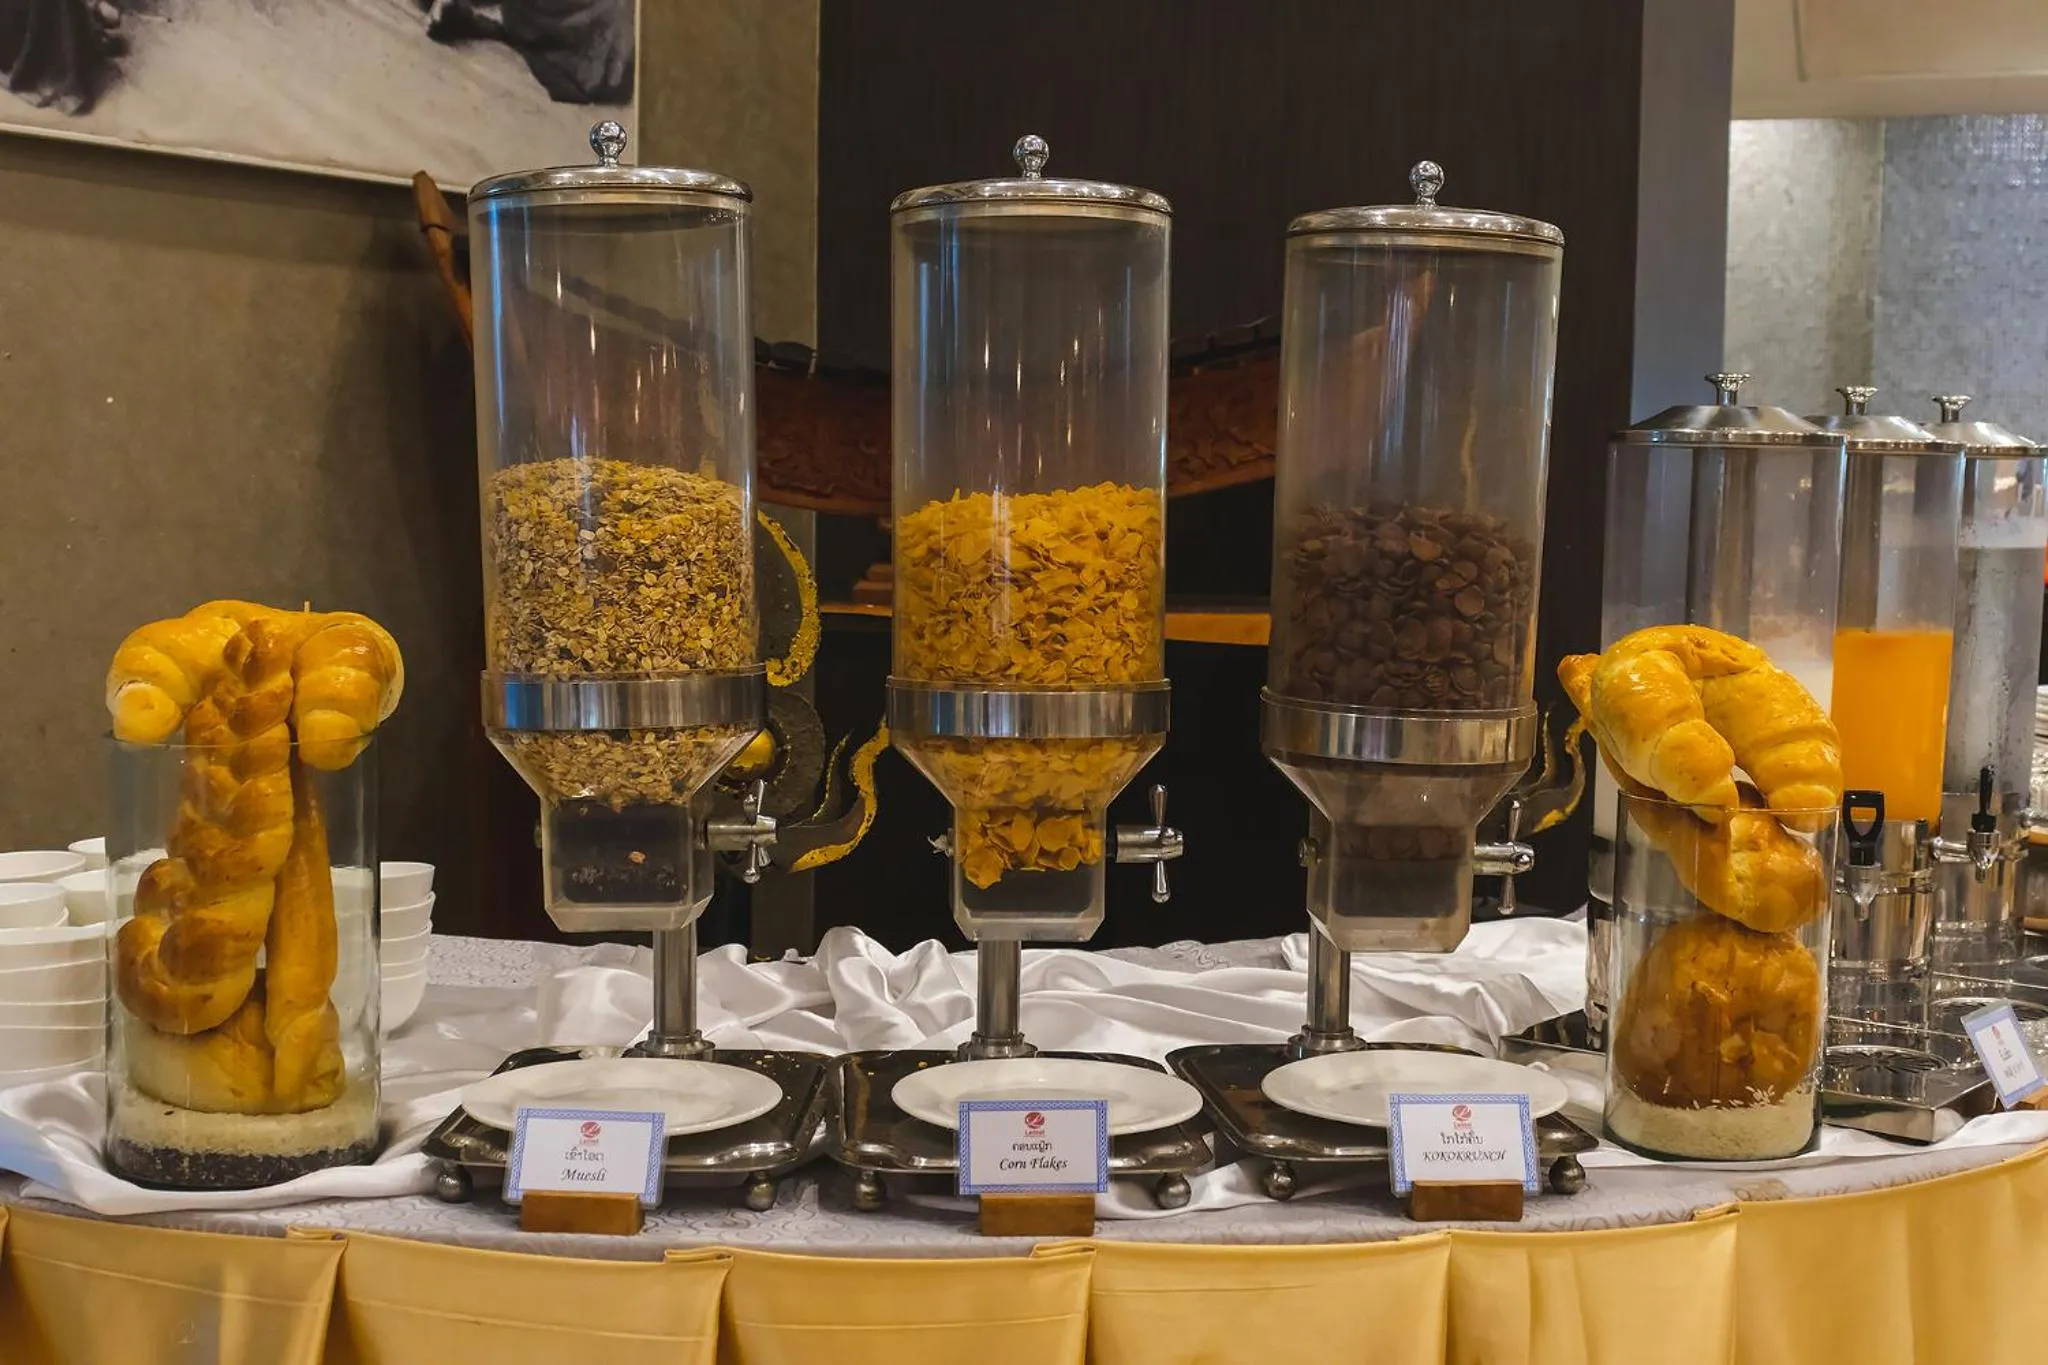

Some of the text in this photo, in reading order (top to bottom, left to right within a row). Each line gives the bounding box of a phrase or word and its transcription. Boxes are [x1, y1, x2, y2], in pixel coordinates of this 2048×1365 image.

[1000, 1156, 1069, 1171] Corn Flakes
[1422, 1150, 1507, 1162] KOKOKRUNCH
[560, 1167, 607, 1182] Muesli
